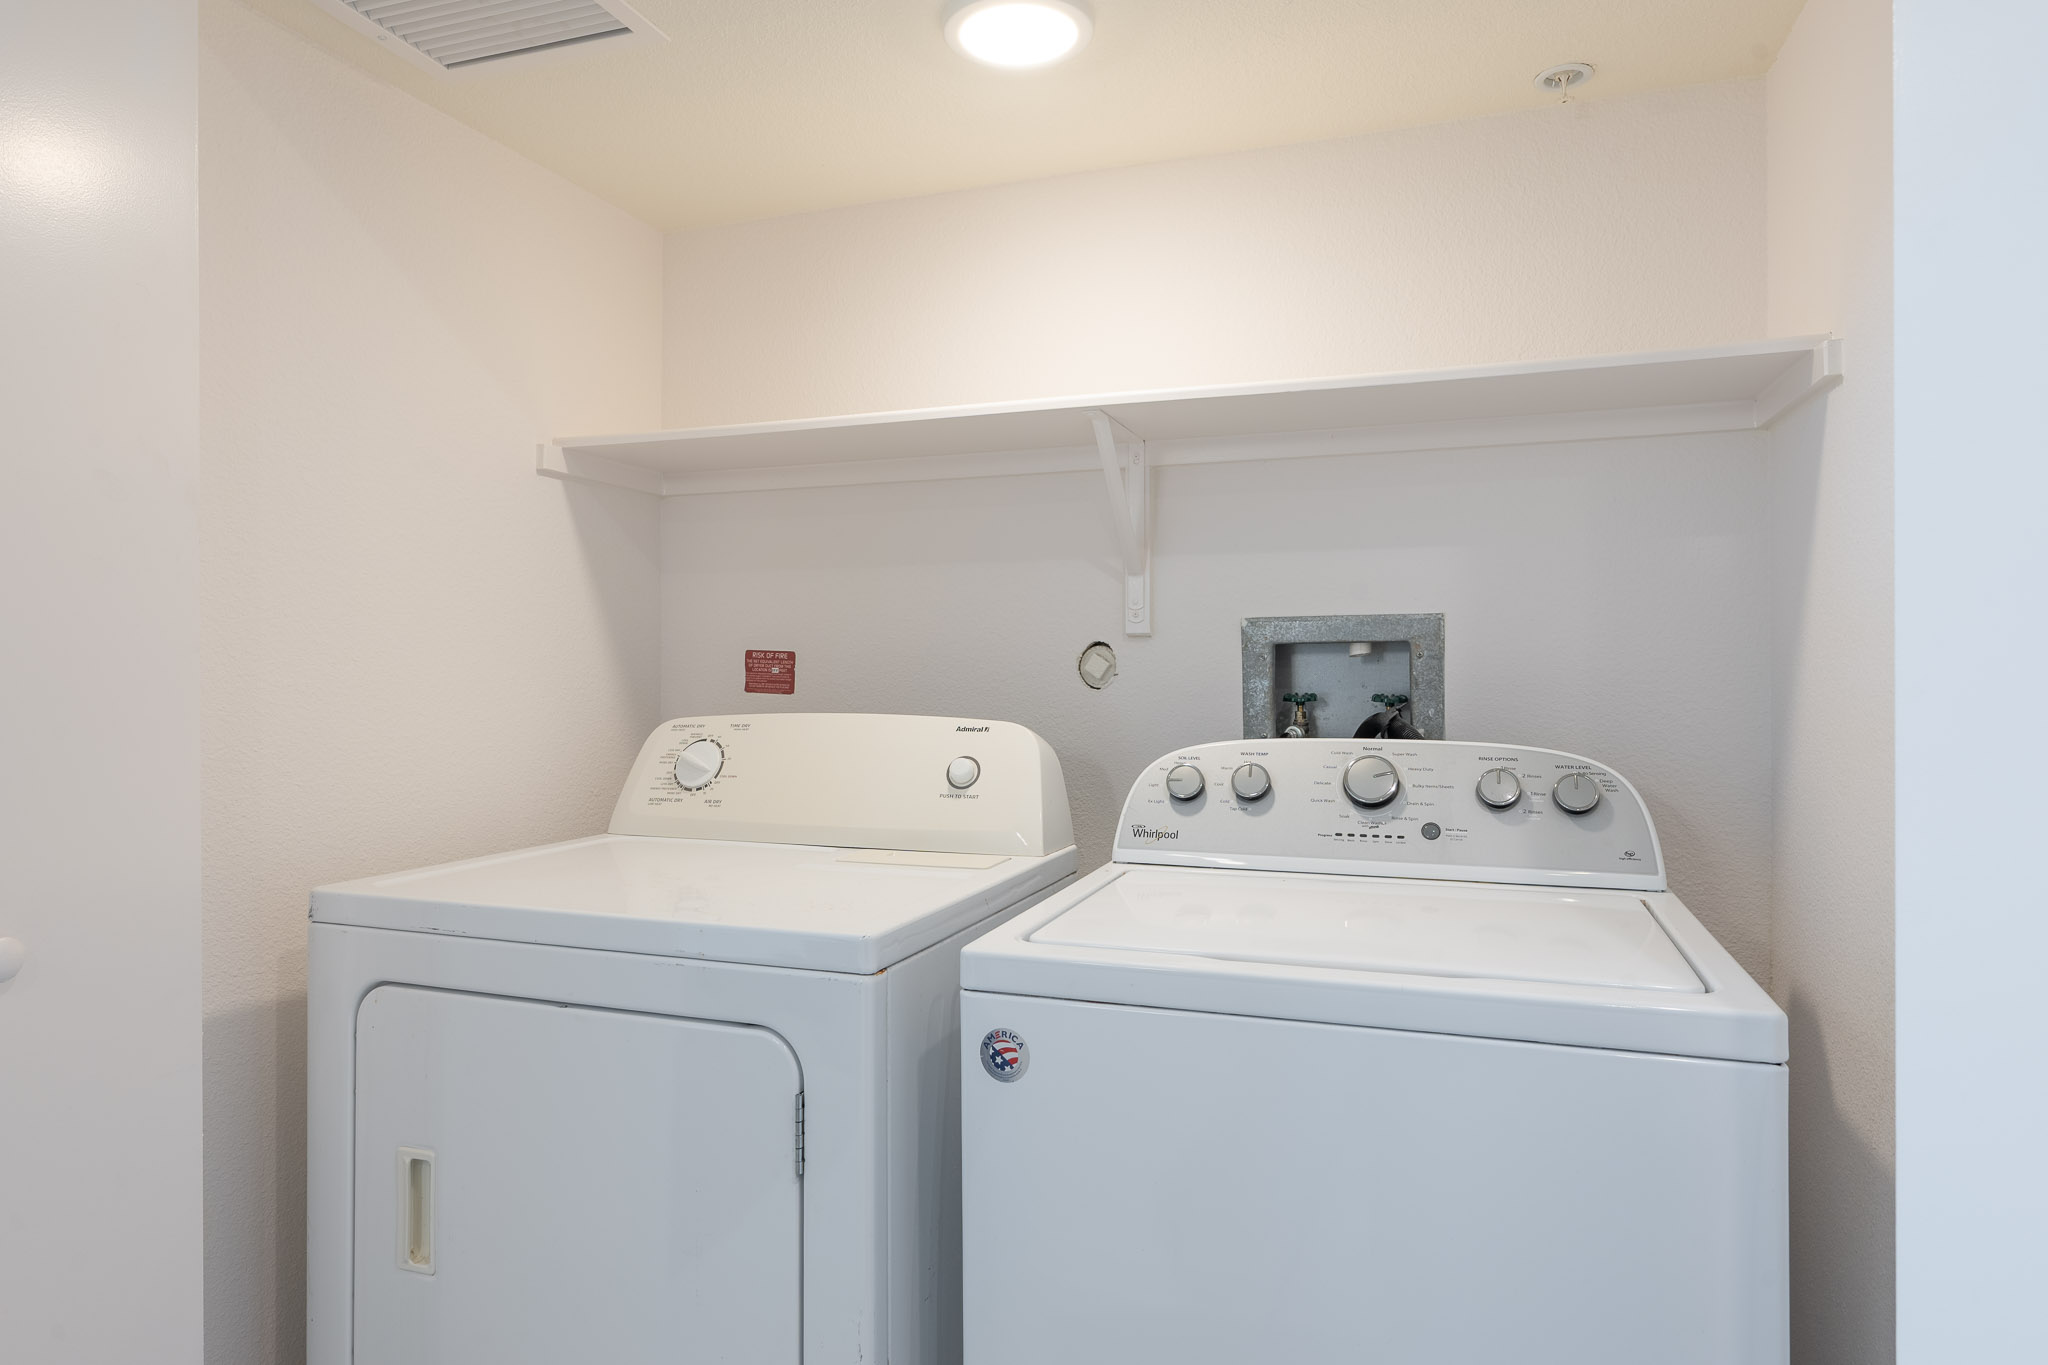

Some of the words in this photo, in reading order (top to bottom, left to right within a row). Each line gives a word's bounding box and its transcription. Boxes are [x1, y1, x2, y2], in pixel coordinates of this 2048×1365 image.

[752, 651, 765, 659] RISK
[1132, 828, 1179, 841] Whirlpool
[984, 1030, 1024, 1050] AMERICA
